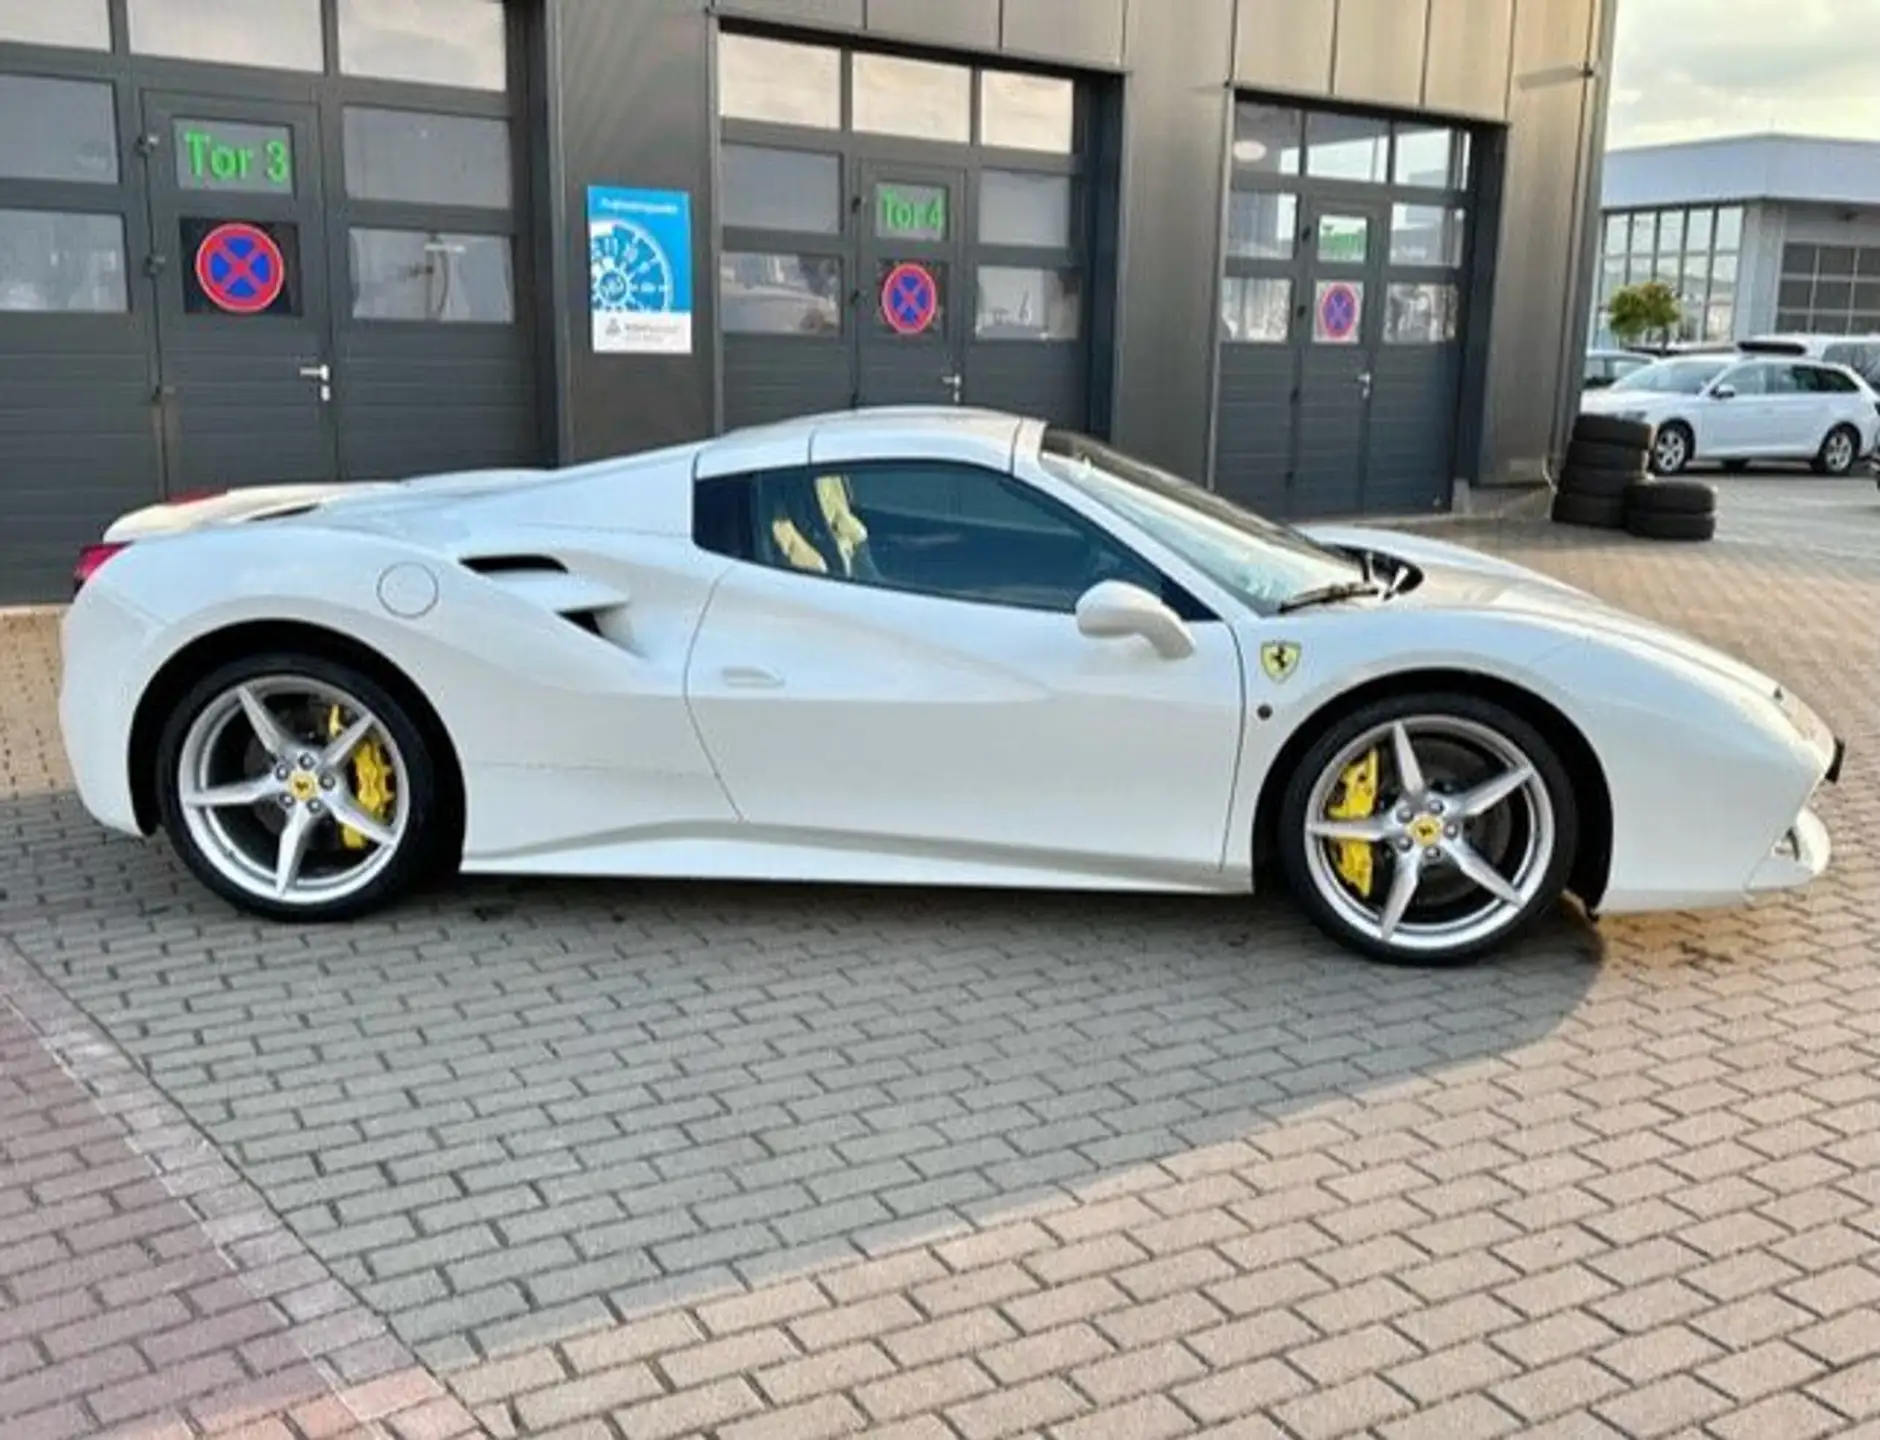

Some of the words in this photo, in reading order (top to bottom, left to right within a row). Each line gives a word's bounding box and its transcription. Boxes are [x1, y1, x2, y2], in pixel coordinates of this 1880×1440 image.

[184, 129, 254, 181] Tor
[265, 140, 287, 184] 3
[882, 189, 923, 231] Tor
[927, 196, 945, 232] 4
